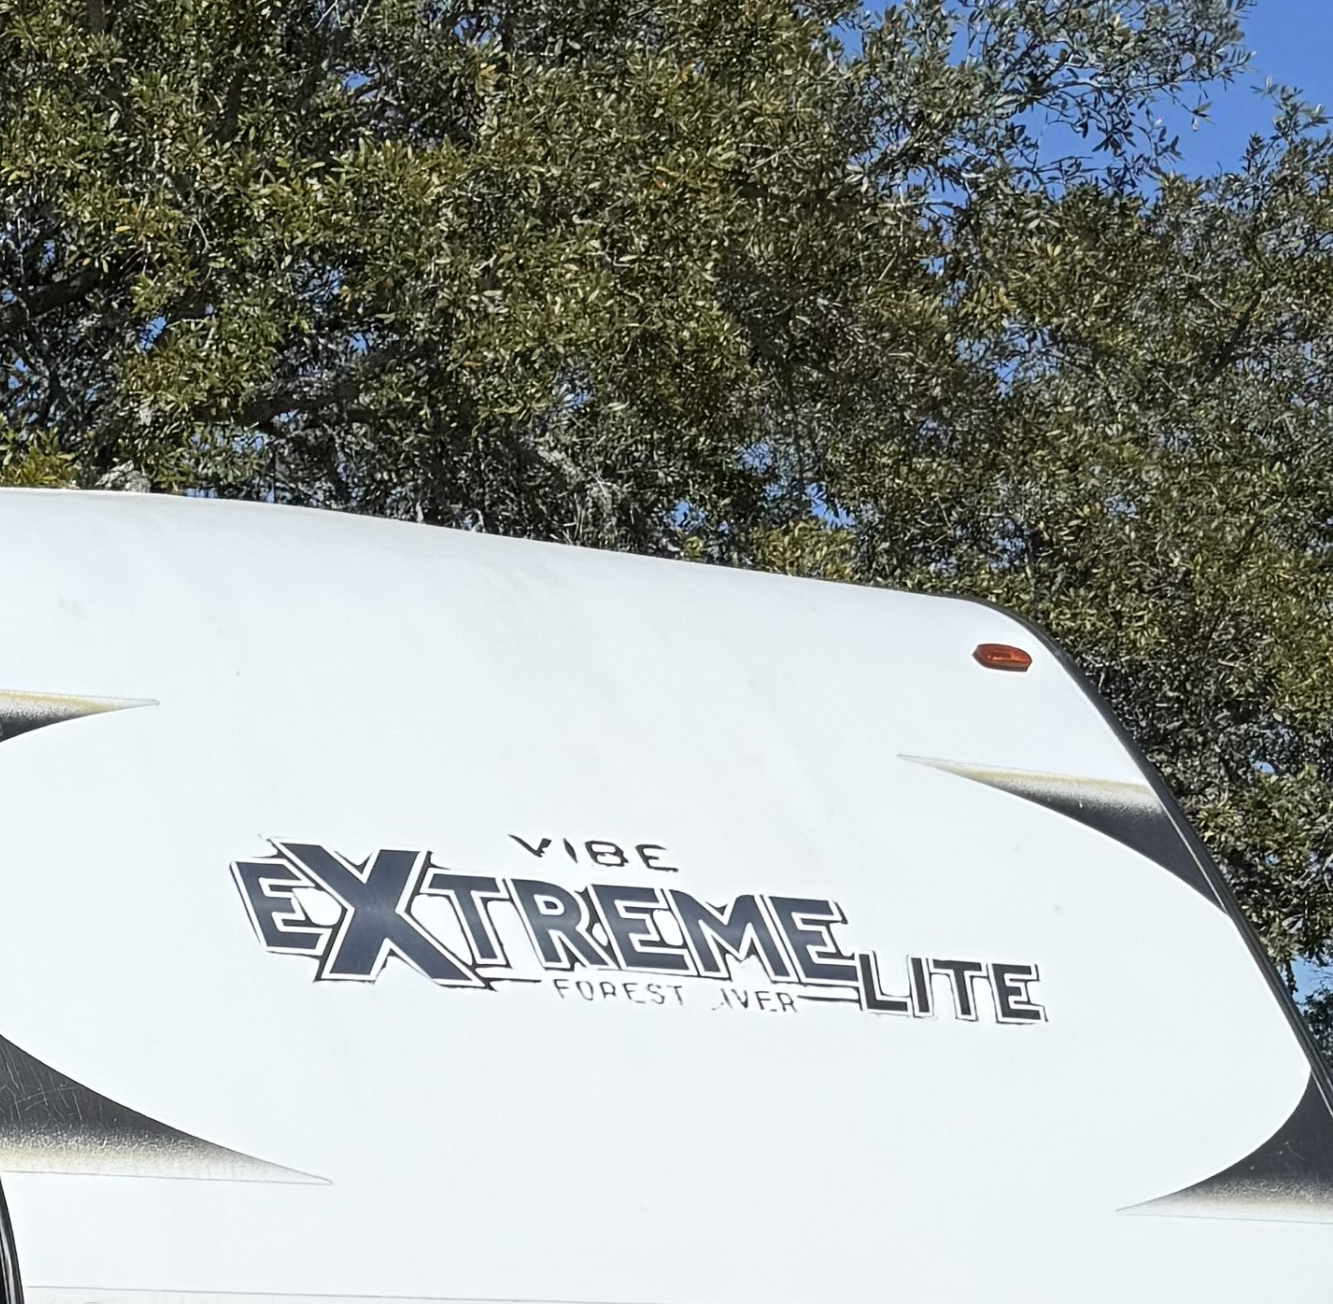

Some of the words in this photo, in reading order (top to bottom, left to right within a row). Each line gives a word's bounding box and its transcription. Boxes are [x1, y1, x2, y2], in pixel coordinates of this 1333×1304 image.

[507, 834, 680, 873] VIBE
[229, 837, 859, 991] EXTREME
[857, 950, 1049, 1025] LITE
[552, 977, 684, 1005] FOREST
[710, 987, 798, 1013] IVER
